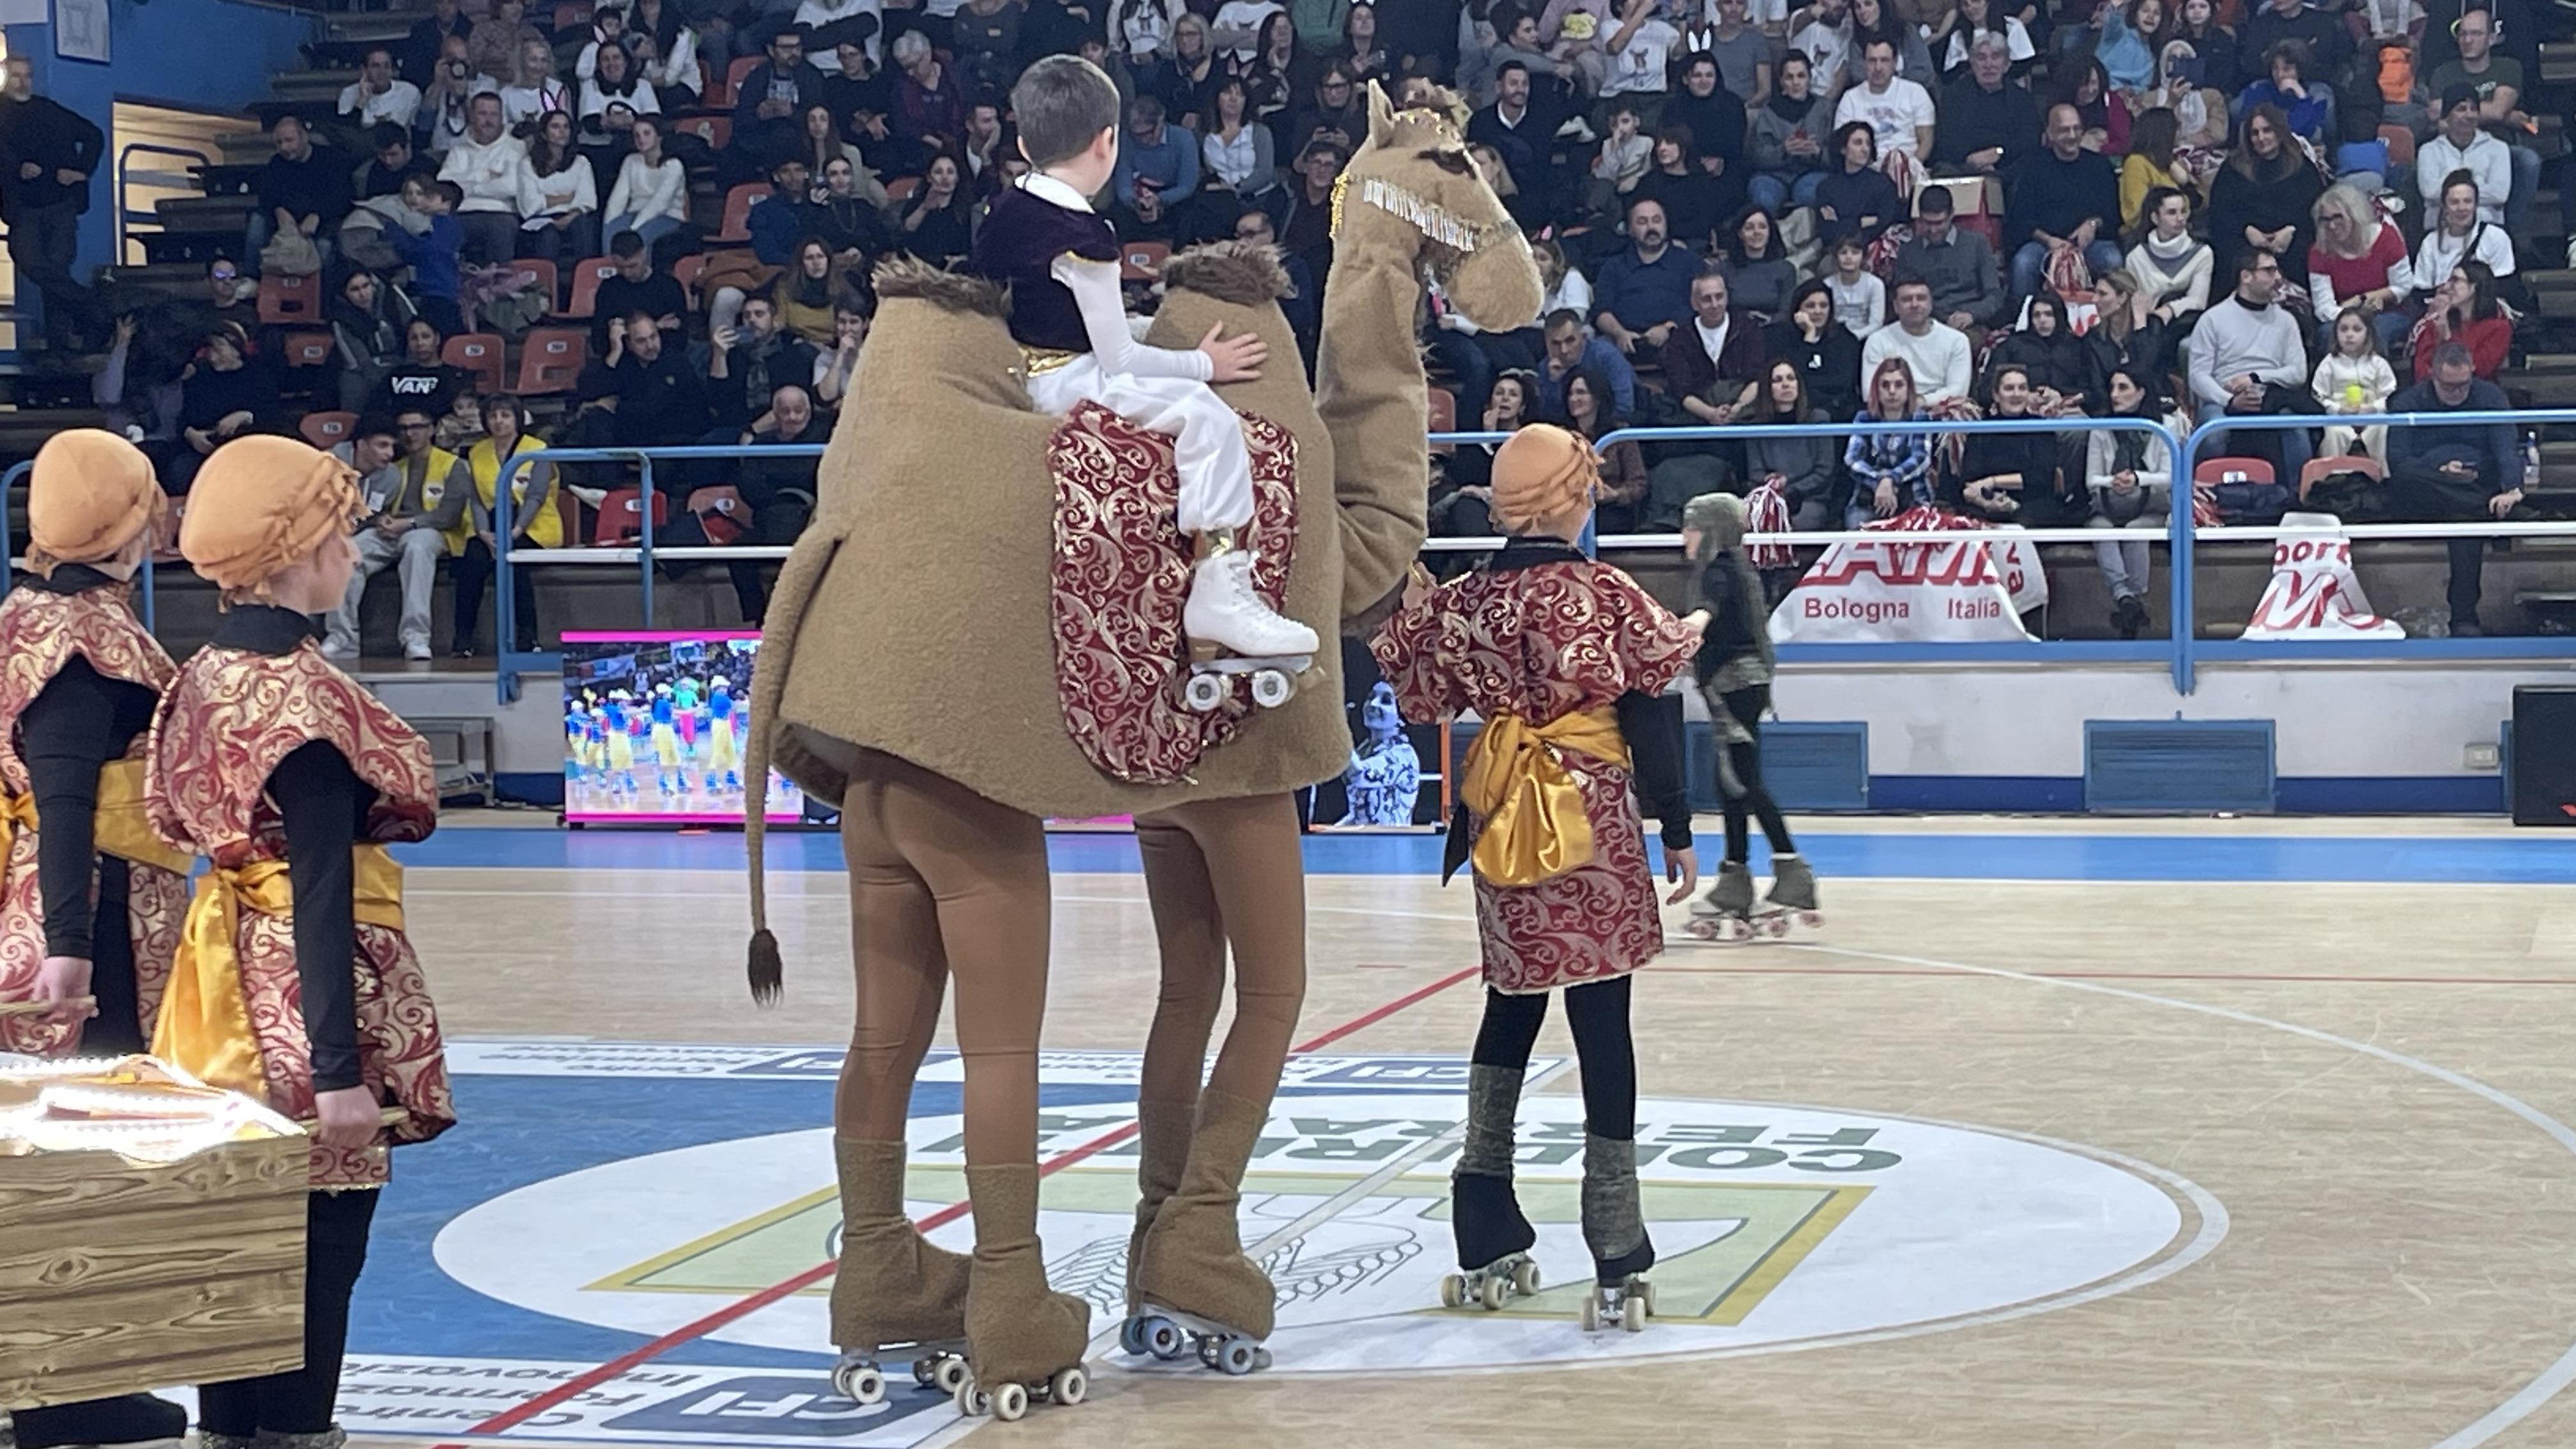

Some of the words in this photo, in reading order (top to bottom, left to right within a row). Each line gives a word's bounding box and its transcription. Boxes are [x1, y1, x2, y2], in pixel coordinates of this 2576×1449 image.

[1805, 598, 1909, 624] Bologna
[1948, 598, 2000, 619] Italia
[777, 1057, 845, 1069] FI
[1349, 1066, 1469, 1078] CFI
[680, 1390, 892, 1420] CFI
